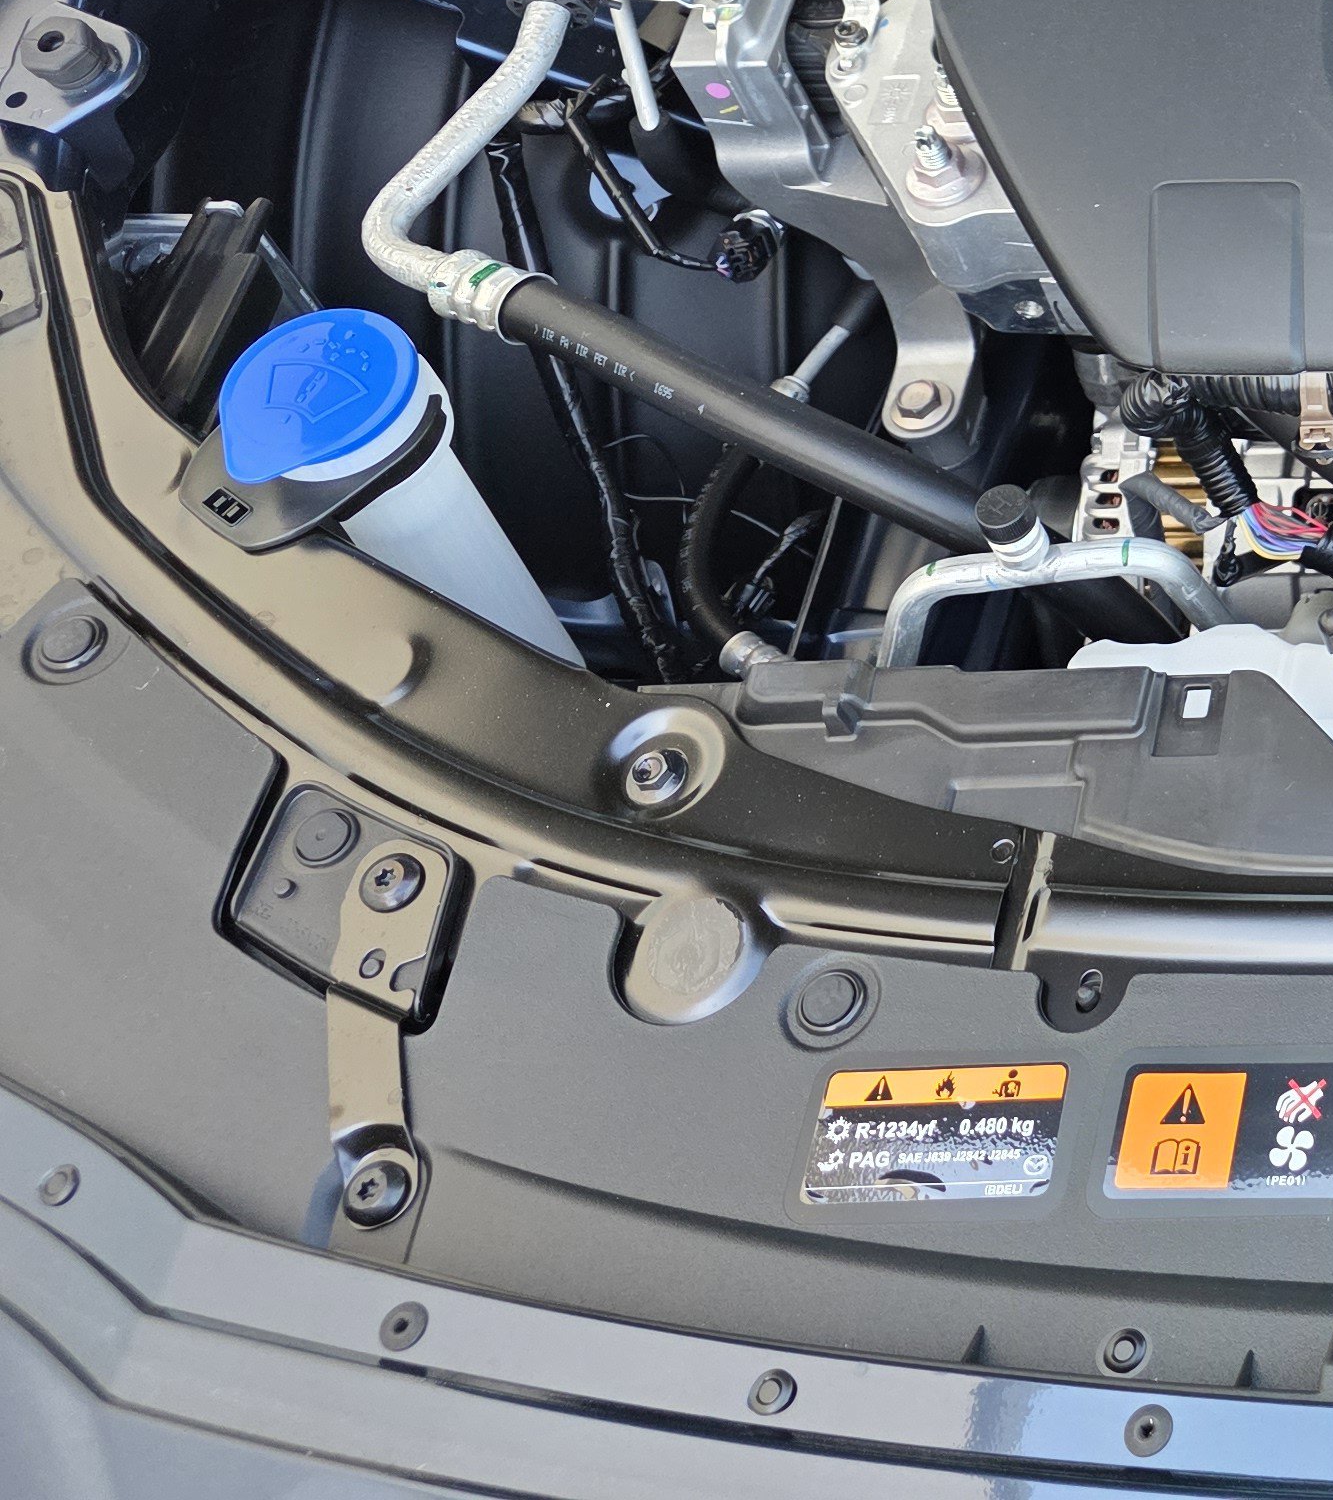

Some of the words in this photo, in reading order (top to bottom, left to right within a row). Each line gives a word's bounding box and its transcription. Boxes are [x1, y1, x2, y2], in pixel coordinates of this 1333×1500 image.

[854, 1119, 938, 1141] R-1234yf
[959, 1118, 1007, 1136] 0.480
[1011, 1116, 1035, 1137] kg
[848, 1150, 890, 1169] PAG
[897, 1152, 923, 1164] SAE
[1265, 1175, 1306, 1187] (PE01)
